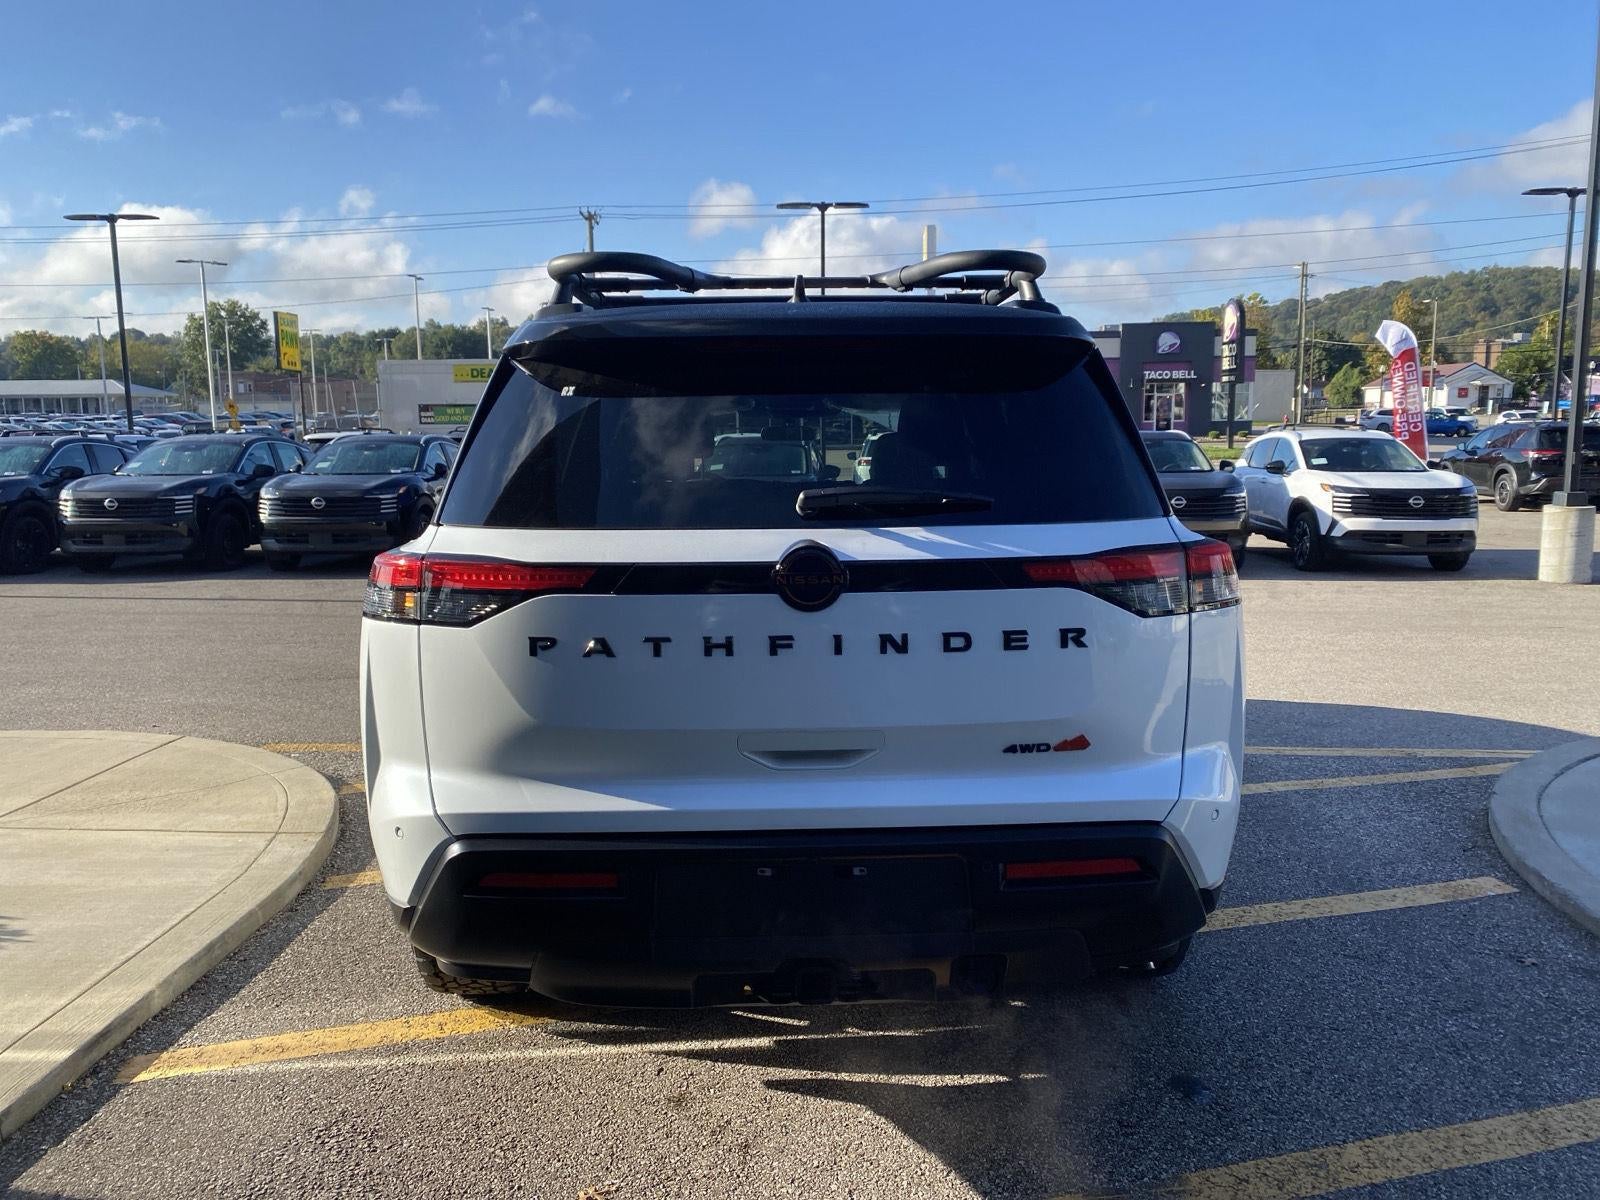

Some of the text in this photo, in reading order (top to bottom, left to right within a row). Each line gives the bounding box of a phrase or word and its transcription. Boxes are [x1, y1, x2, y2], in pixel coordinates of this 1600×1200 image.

[1222, 343, 1237, 357] TACO
[1222, 356, 1237, 371] BELL
[1143, 370, 1198, 379] TACO BELL
[776, 575, 844, 585] NISSAN
[528, 627, 1089, 658] PATHFINDER
[1002, 742, 1052, 754] 4WD
